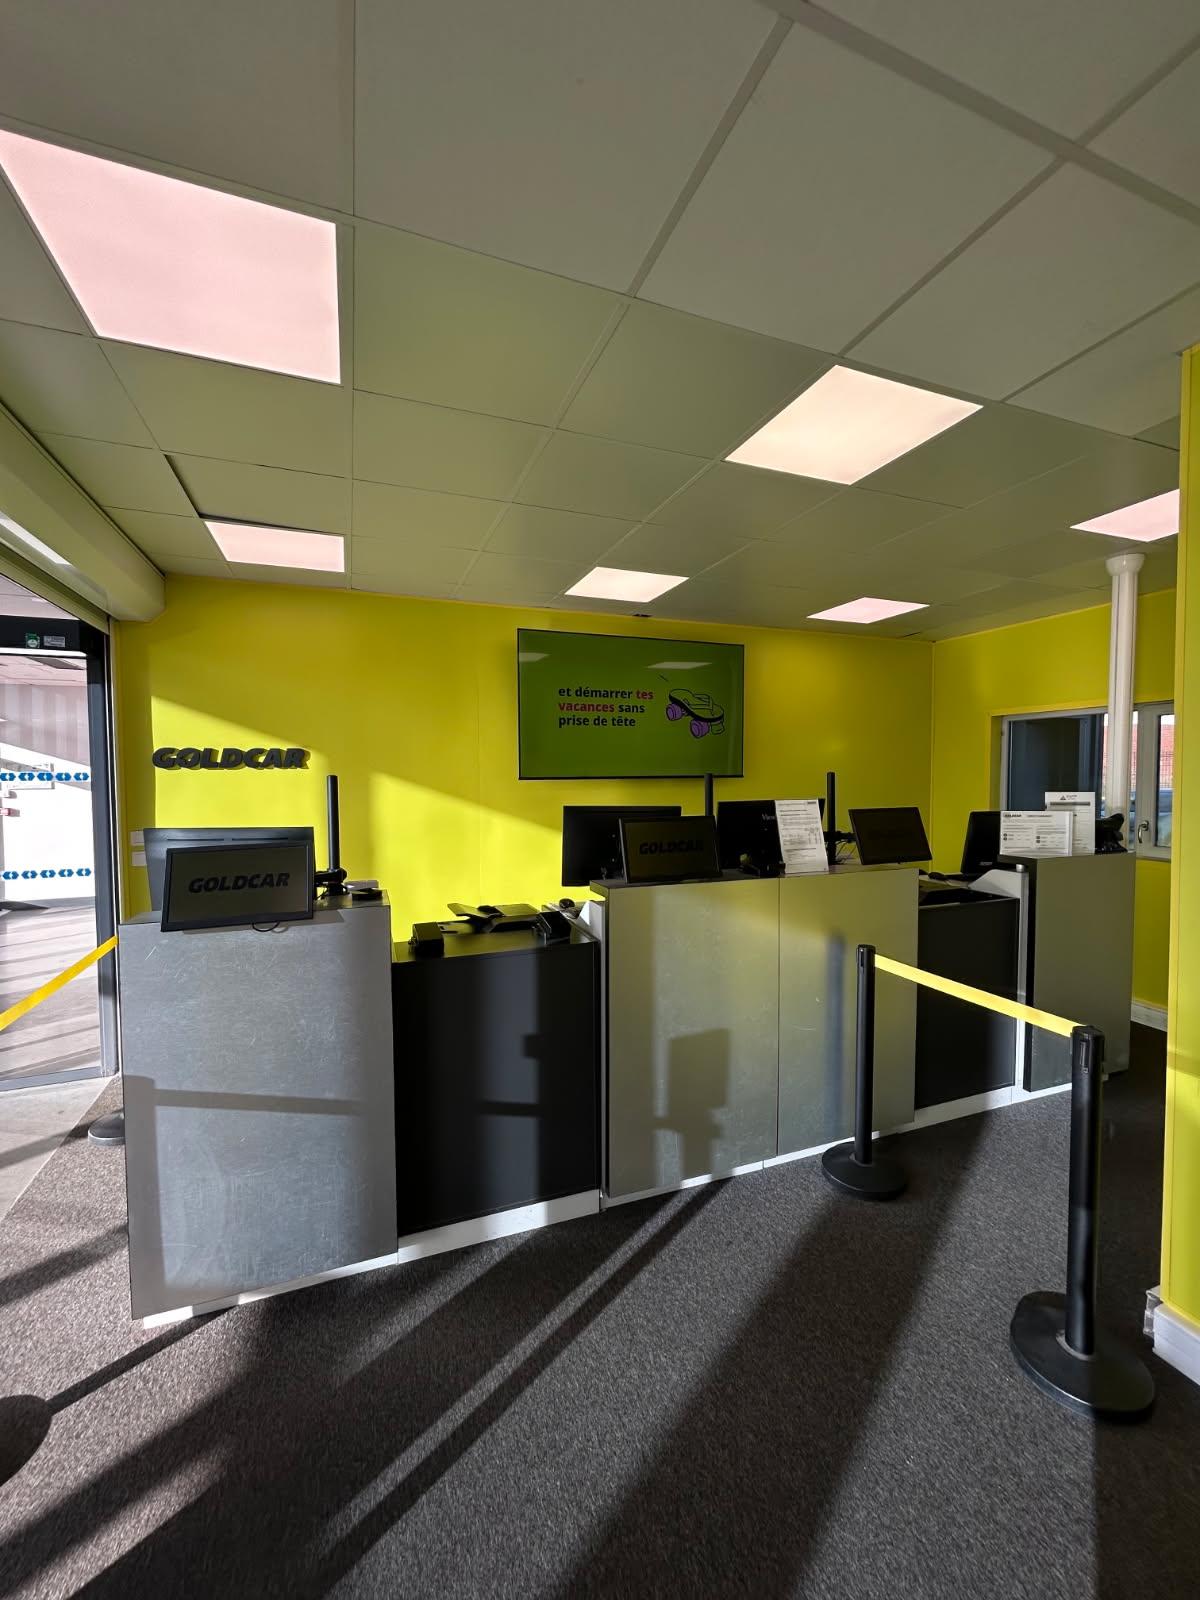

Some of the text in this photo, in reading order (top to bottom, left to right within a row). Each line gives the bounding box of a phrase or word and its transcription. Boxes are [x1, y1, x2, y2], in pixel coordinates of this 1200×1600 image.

[558, 686, 654, 700] et démarrer tes
[558, 702, 645, 713] vacances sans
[558, 715, 636, 728] prise de tête
[152, 747, 306, 769] GOLDCAR
[640, 840, 704, 854] GOLDC
[189, 873, 290, 894] GOLDCAR
